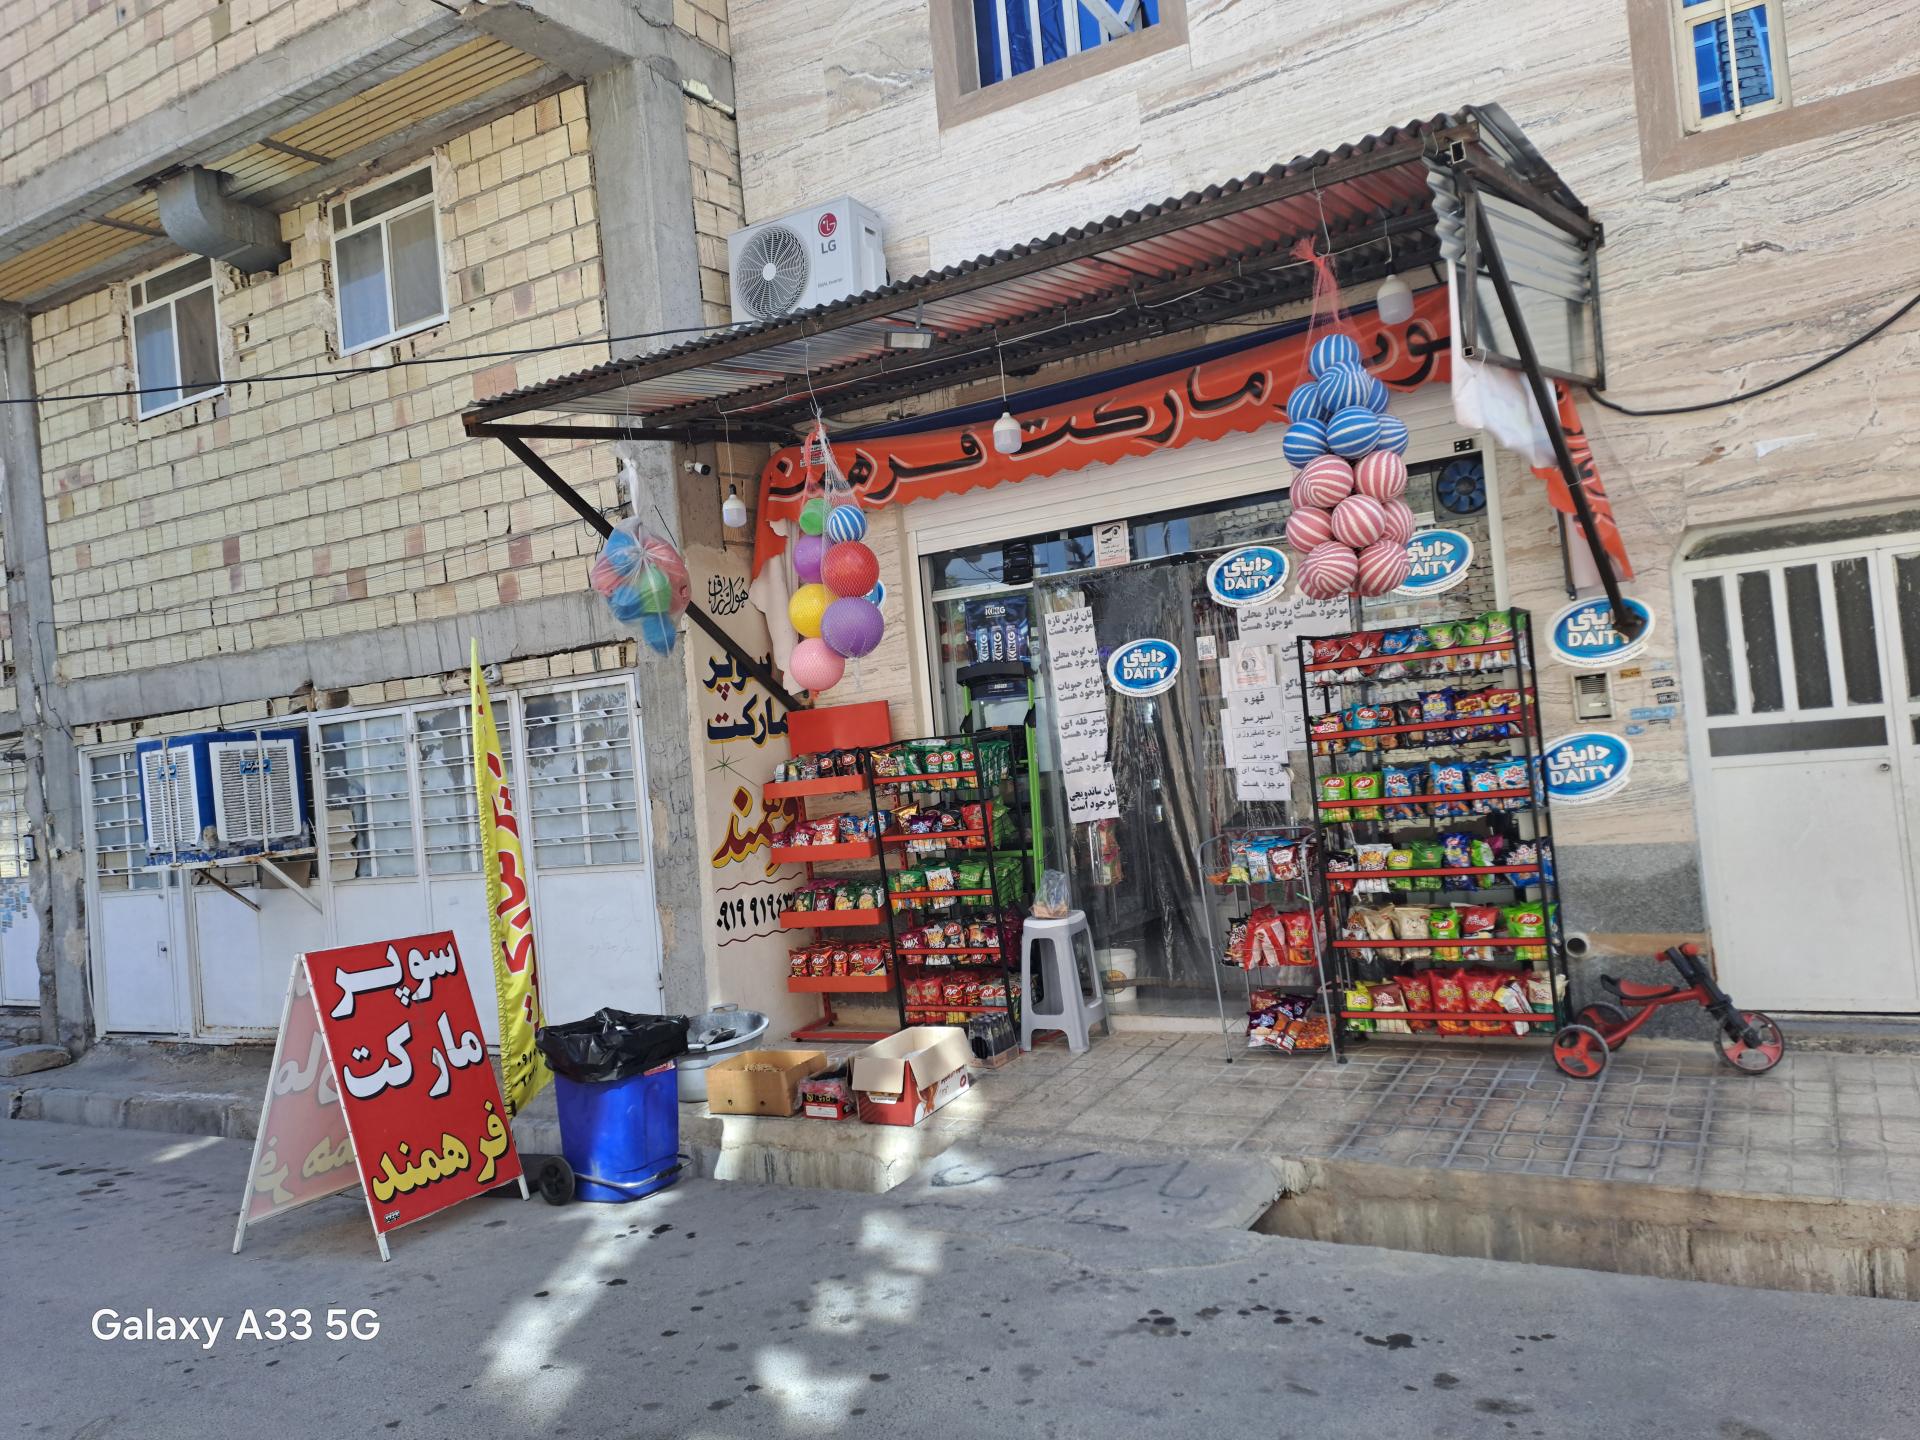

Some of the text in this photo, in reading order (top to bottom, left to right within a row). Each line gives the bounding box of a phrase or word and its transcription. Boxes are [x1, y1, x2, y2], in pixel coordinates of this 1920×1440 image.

[821, 239, 837, 255] LG
[1009, 364, 1273, 458] مارکت
[1408, 560, 1456, 577] AITY
[1224, 575, 1274, 591] DAITY
[1062, 611, 1079, 624] لواش
[1081, 609, 1092, 621] نان
[1240, 606, 1293, 622] رب انار محلی
[1293, 608, 1349, 619] موجود هست
[1567, 607, 1616, 632] ایتی
[1048, 623, 1093, 636] موجود هست
[1240, 618, 1294, 632] موجود هست
[994, 631, 1004, 662] KING
[1007, 631, 1017, 662] KING
[1053, 650, 1069, 662] محلی
[1123, 648, 1167, 668] دایتی
[1054, 658, 1099, 671] موجود هست
[1123, 666, 1168, 680] DAITY
[1057, 680, 1082, 691] حبوبات
[1059, 692, 1078, 701] هست
[1079, 688, 1104, 700] موجود
[1244, 691, 1265, 705] قهوه
[1061, 727, 1108, 739] موجود هست
[1547, 744, 1611, 770] دایتی
[1065, 762, 1112, 774] موجود هست
[1551, 763, 1614, 786] DAITY
[1070, 783, 1115, 801] نان ساندویچی
[1070, 799, 1117, 812] موجود است
[331, 944, 459, 1020] سوپر
[343, 1011, 485, 1099] مارکت
[371, 1100, 511, 1204] فرهمند
